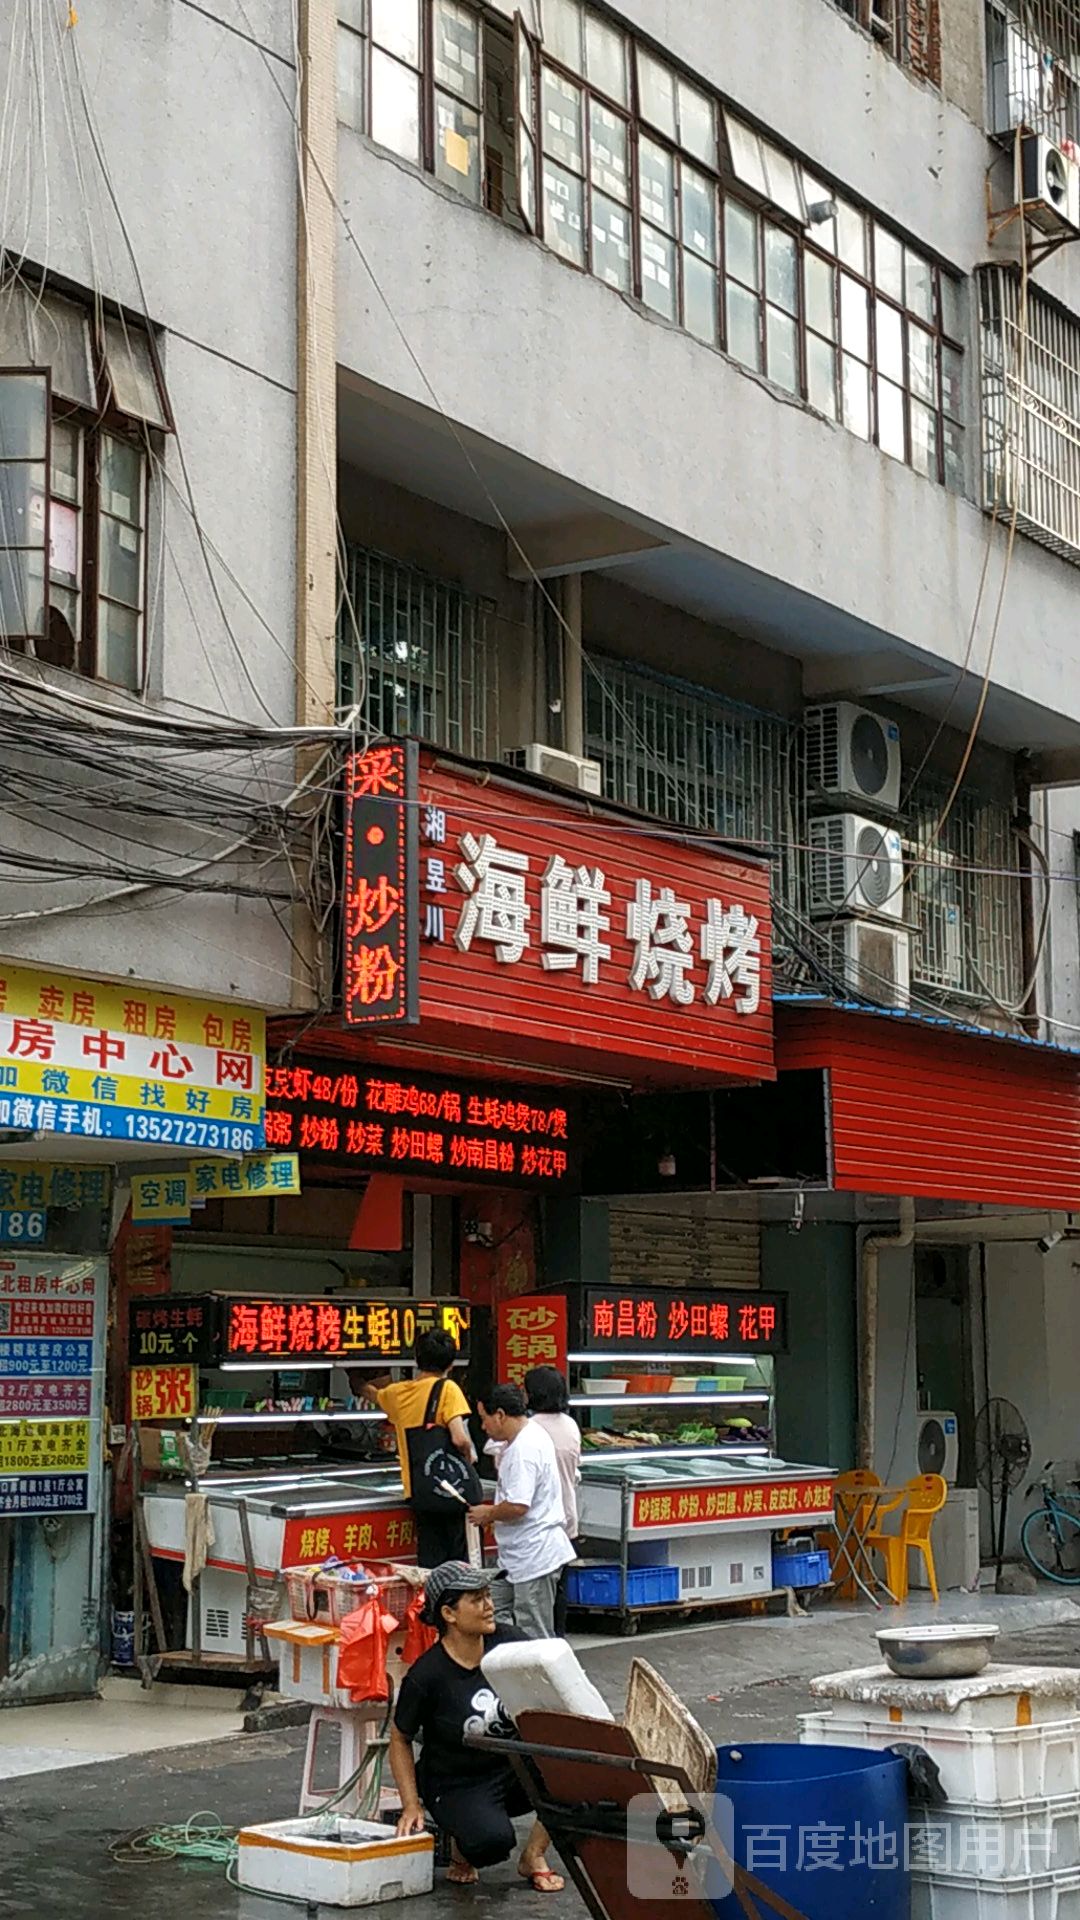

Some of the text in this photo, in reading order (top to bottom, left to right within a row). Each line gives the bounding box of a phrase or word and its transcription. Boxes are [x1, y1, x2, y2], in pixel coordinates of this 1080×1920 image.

[454, 831, 761, 1016] 海鲜烧烤
[38, 985, 96, 1028] 卖房
[123, 1000, 177, 1041] 租房
[202, 1012, 252, 1051] 包房
[6, 1017, 254, 1090] 房中心网
[300, 1115, 339, 1151] 炒粉
[345, 1120, 384, 1155] 炒菜
[391, 1126, 443, 1164] 炒田螺
[139, 1157, 294, 1209] 空调 家电修理
[0, 1212, 43, 1238] 86
[593, 1300, 776, 1341] 南昌粉 炒田螺 花甲
